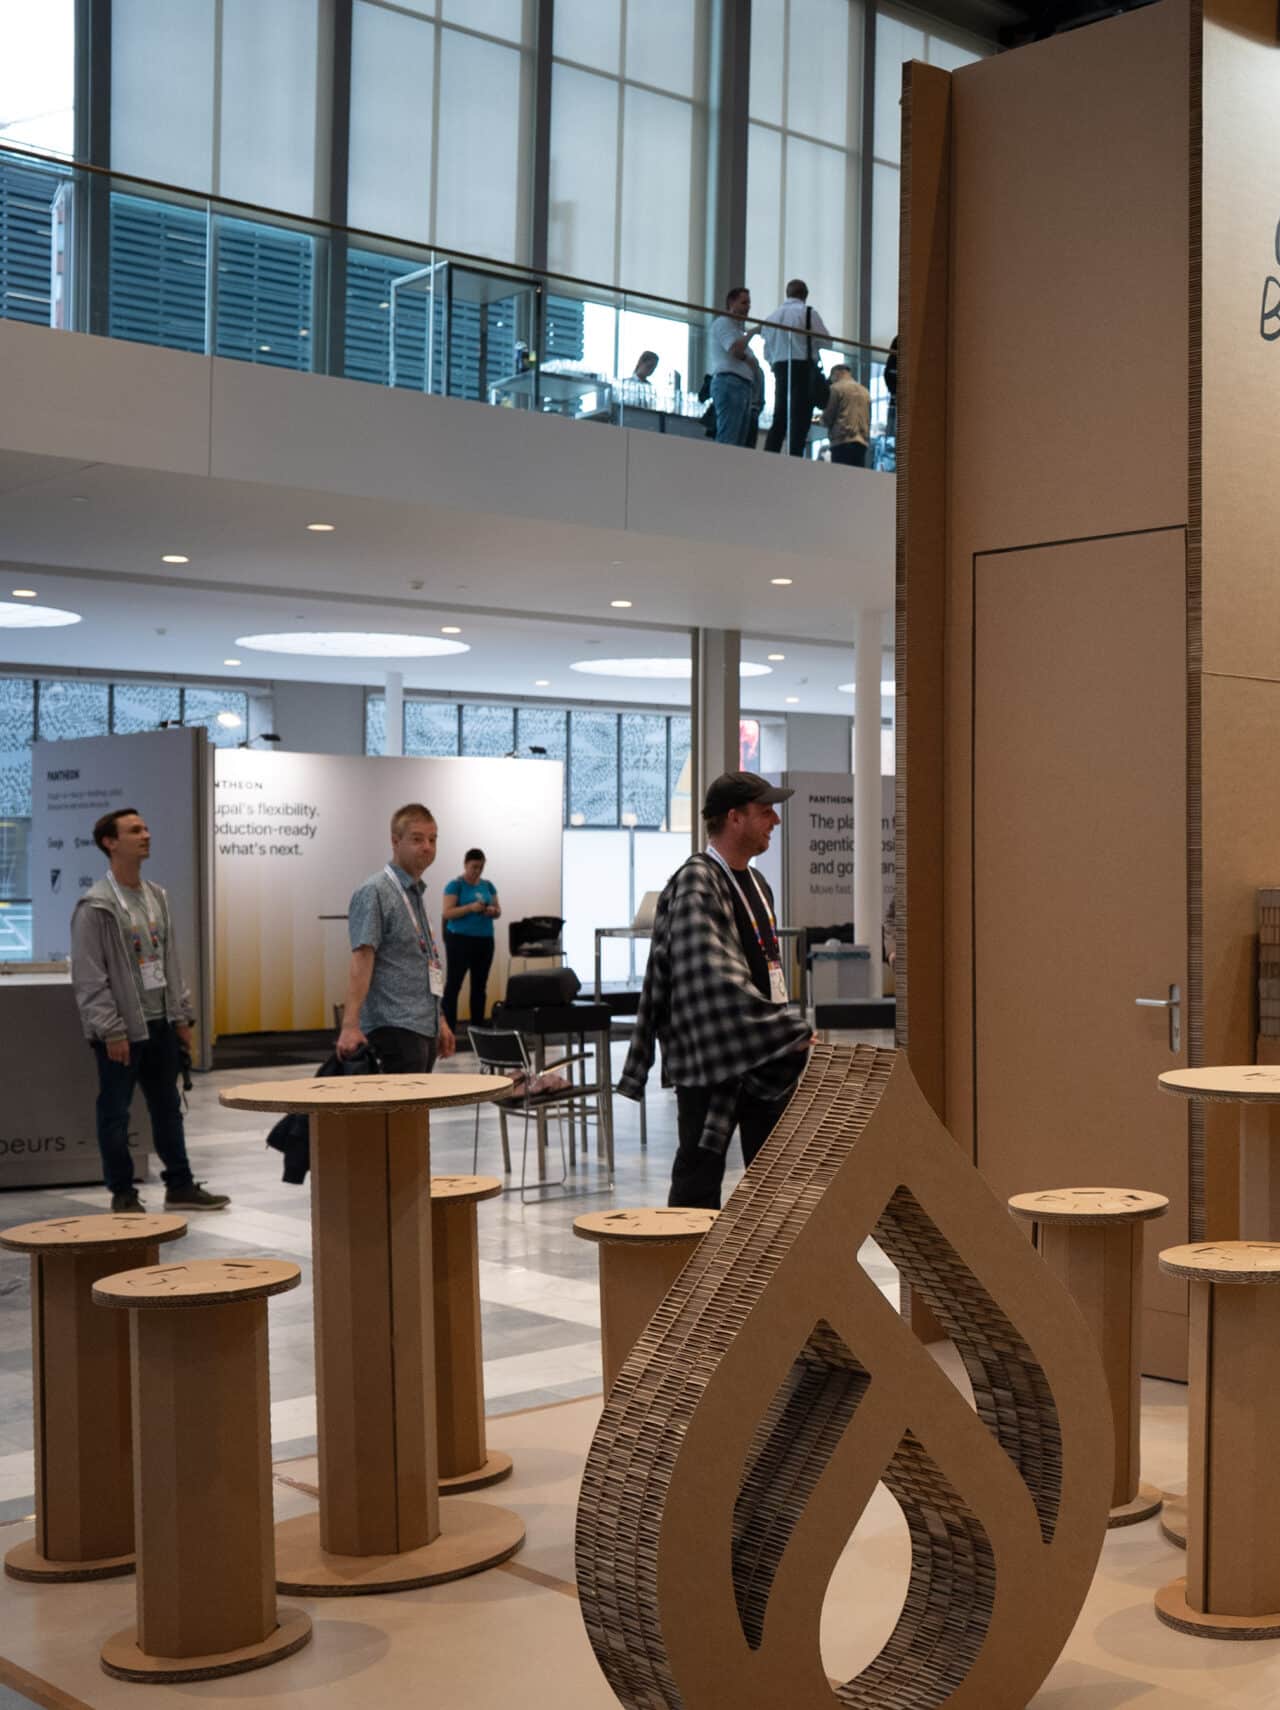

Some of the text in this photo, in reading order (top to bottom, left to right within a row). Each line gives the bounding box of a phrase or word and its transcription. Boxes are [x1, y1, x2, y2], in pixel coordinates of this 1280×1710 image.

[258, 803, 320, 820] flexibility.
[810, 813, 834, 829] The
[218, 842, 304, 857] what's next.
[809, 835, 855, 855] agentic
[810, 859, 834, 874] and
